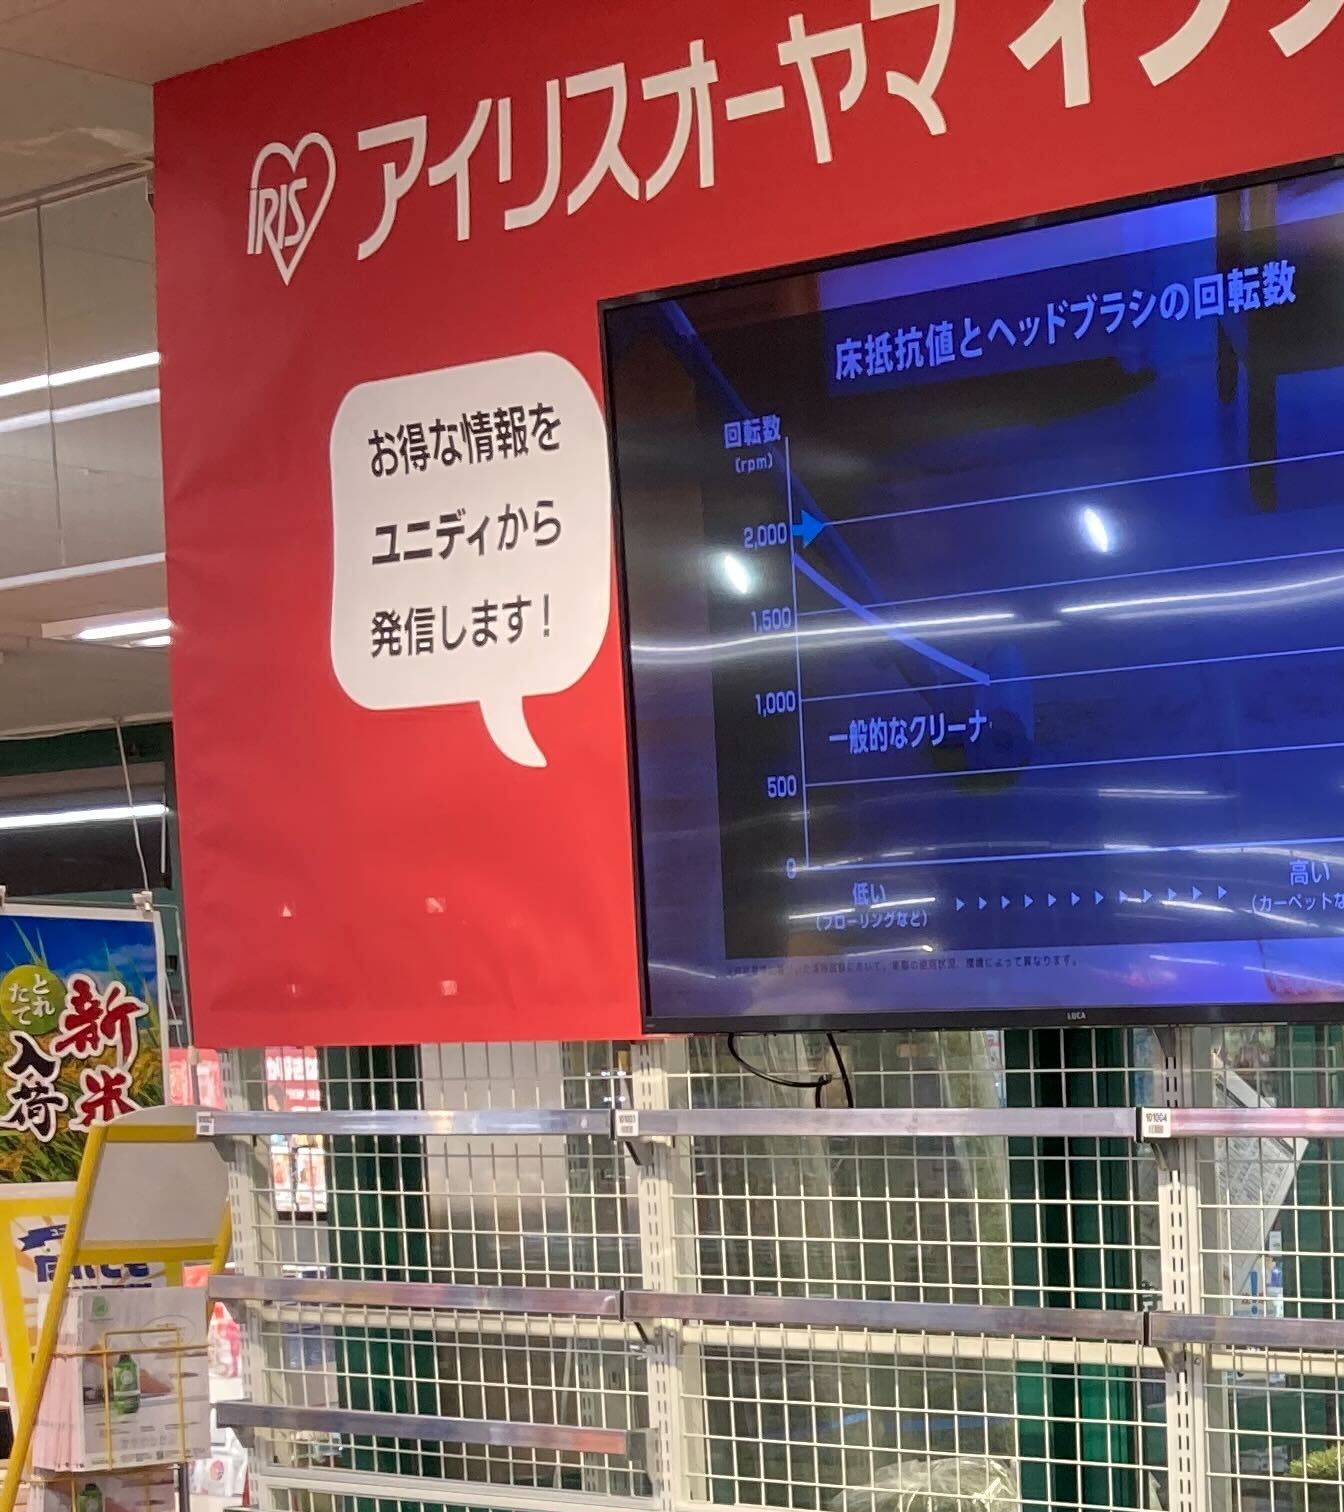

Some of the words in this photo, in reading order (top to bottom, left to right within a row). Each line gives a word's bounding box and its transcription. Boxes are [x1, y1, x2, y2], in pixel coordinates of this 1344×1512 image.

[246, 178, 307, 255] IRIS
[357, 0, 956, 260] アイリスオーヤマ
[834, 259, 1297, 381] 床抵抗値とヘッドブラシの回転数
[368, 402, 561, 477] お得な情報を
[723, 414, 782, 449] 回転数
[735, 452, 773, 473] (rpm)
[371, 500, 561, 565] ユニディから
[743, 522, 788, 549] 2,000
[751, 607, 792, 633] 1,500
[755, 690, 796, 717] 1,000
[767, 775, 798, 799] 500
[1289, 861, 1330, 886] 高い
[54, 977, 144, 1128] 新米
[5, 1034, 66, 1138] 入荷
